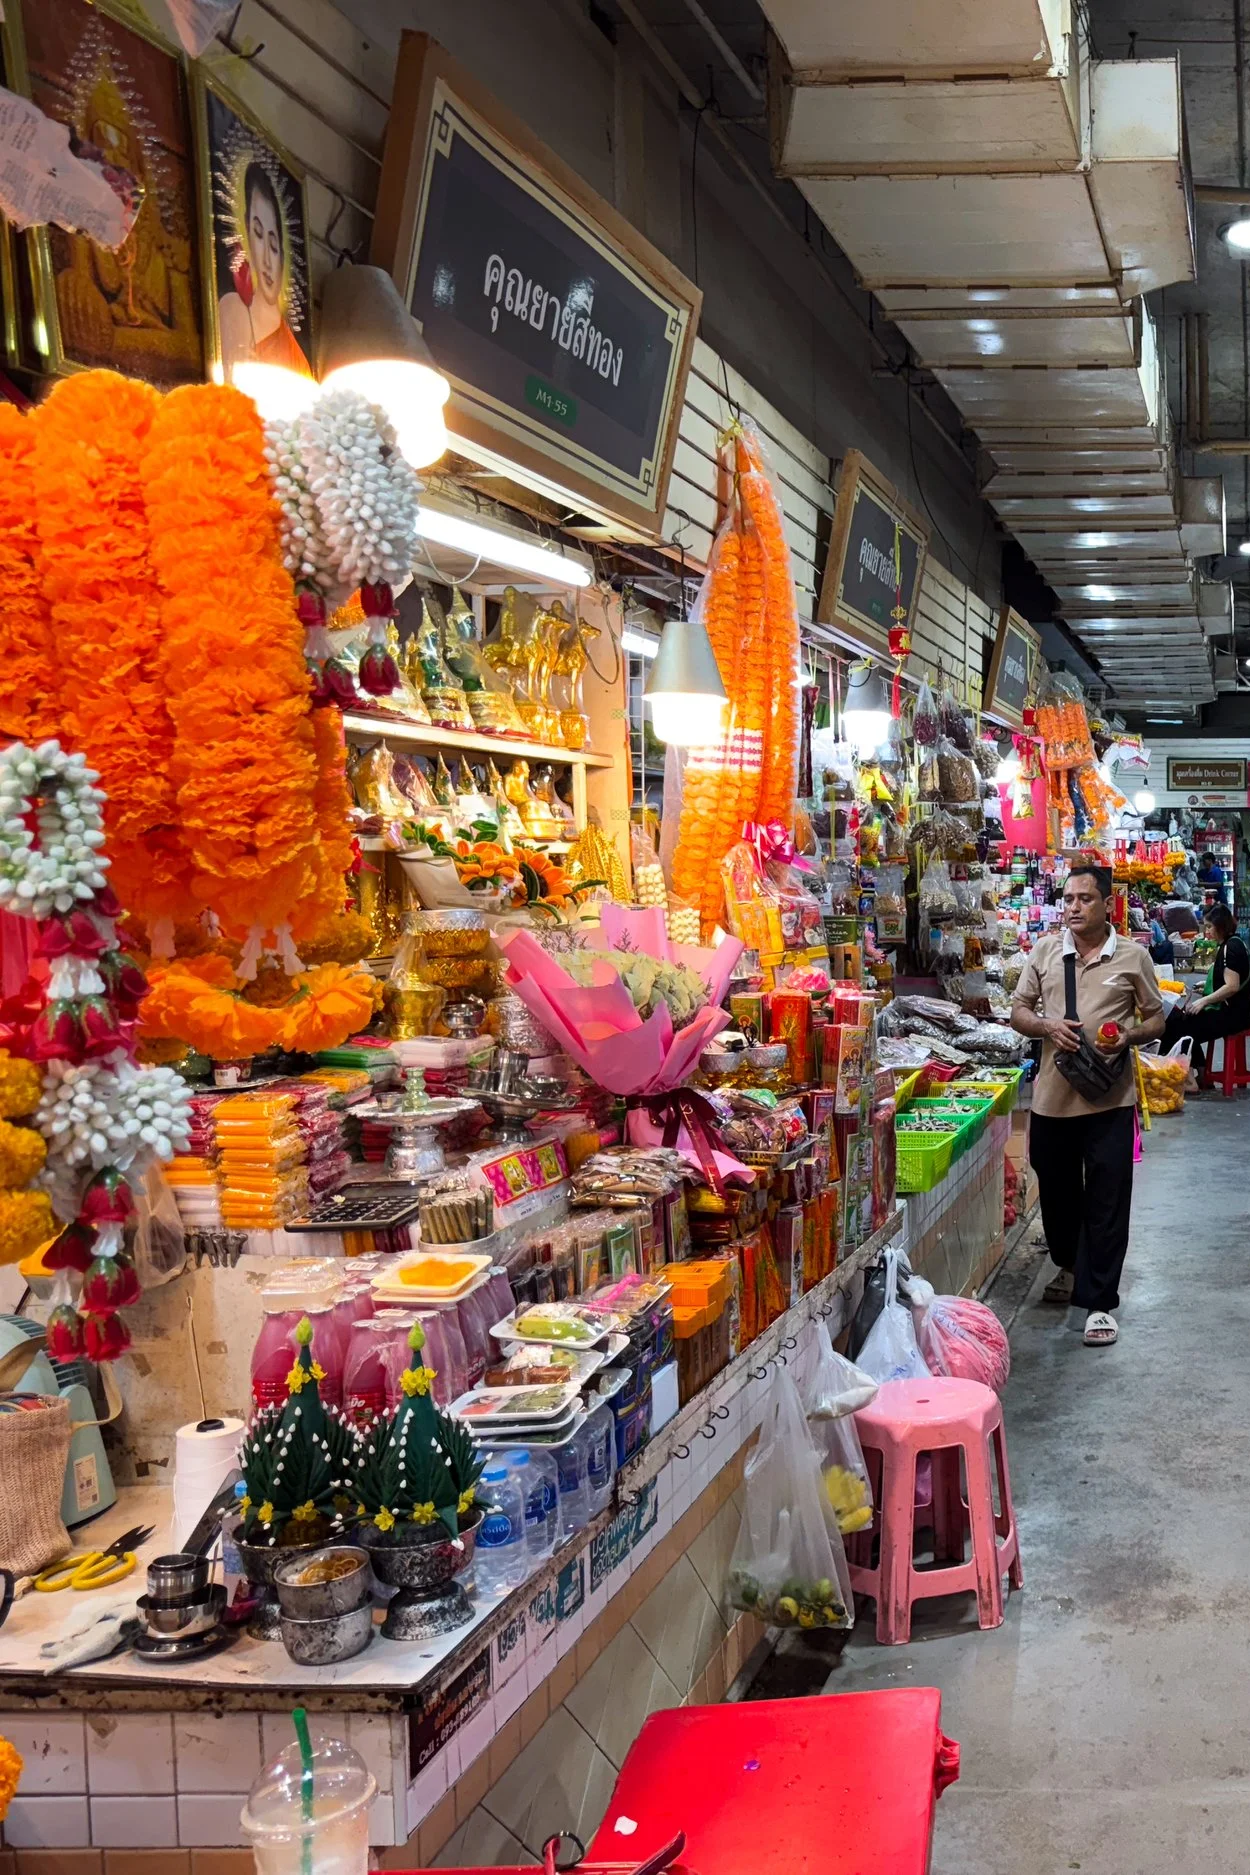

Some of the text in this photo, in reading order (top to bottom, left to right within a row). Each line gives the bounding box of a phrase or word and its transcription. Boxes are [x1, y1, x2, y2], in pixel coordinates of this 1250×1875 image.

[483, 253, 624, 387] คุณยายสีทอง
[1204, 769, 1220, 777] Drink
